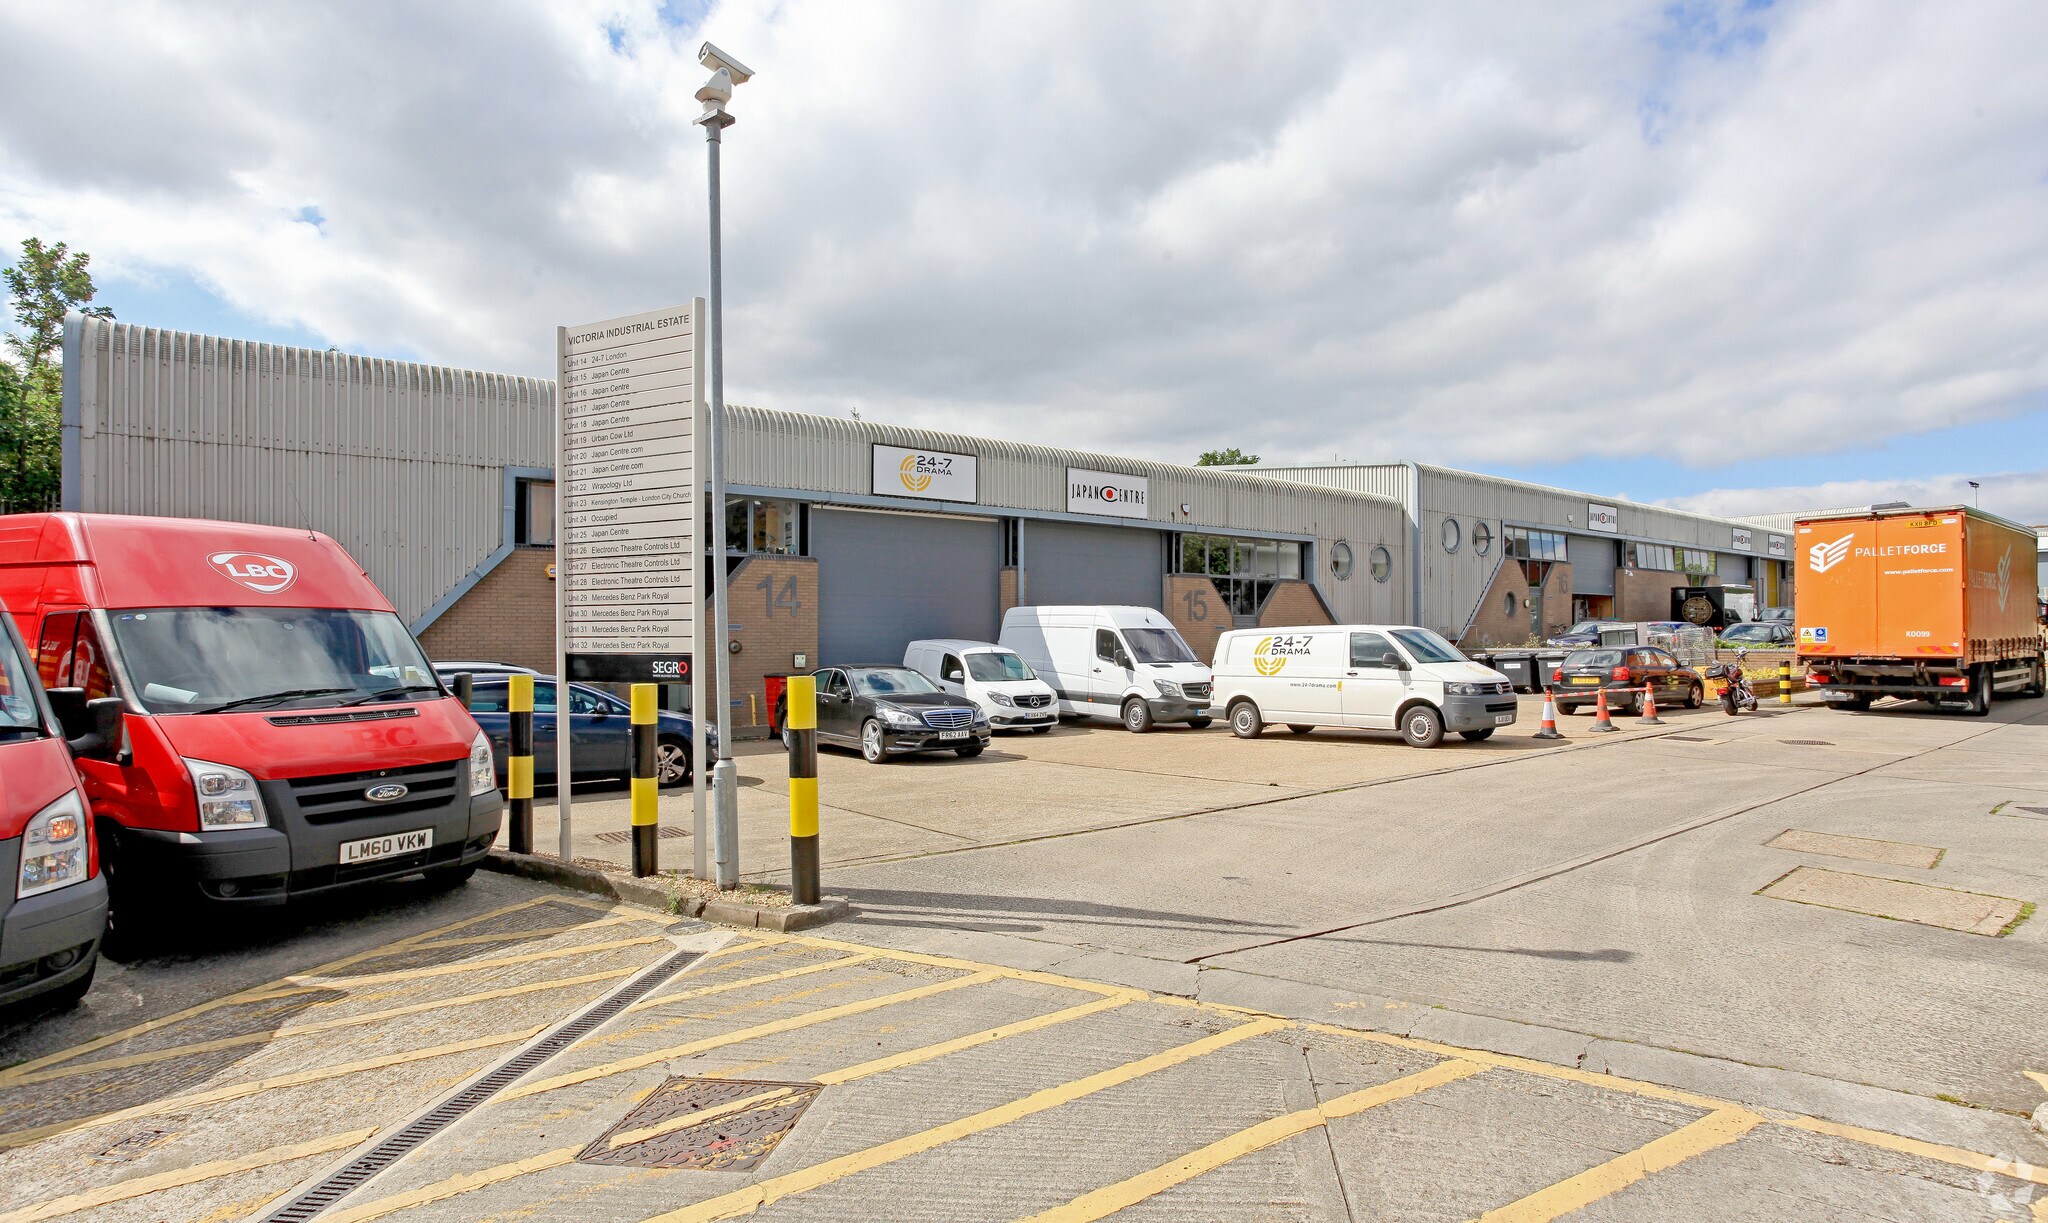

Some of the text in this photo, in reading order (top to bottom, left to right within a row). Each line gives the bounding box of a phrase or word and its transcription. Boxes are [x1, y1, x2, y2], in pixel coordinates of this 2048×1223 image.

[568, 314, 690, 345] VICTORIA INDUSTRIAL ESTATE
[567, 358, 579, 368] Unit
[592, 355, 604, 363] 24-7
[606, 351, 627, 361] London
[567, 368, 630, 383] Unit 15 Japan Centre
[567, 390, 579, 399] Unit
[591, 387, 609, 396] Japan
[610, 383, 630, 393] Centre
[567, 405, 579, 415] Unit
[591, 403, 609, 412] Japan
[610, 399, 630, 408] Centre
[567, 415, 630, 430] Unit 18 Japan Centre
[567, 437, 579, 446] Unit
[591, 434, 609, 443] Urban
[610, 432, 622, 440] Cow
[624, 430, 633, 438] Ltd
[567, 452, 579, 461] Unit
[580, 452, 587, 460] 20
[591, 450, 609, 459] Japan
[916, 455, 953, 469] 24-7
[567, 468, 579, 477] Unit
[591, 466, 609, 475] Japan
[916, 466, 953, 476] DRAMA
[567, 483, 579, 493] Unit
[592, 481, 622, 490] Wrapology
[623, 479, 632, 487] Ltd
[1071, 483, 1099, 500] JAPAN
[567, 499, 579, 508] Unit
[580, 499, 587, 507] 23
[591, 498, 618, 507] Kensington
[620, 496, 637, 504] Temple
[642, 494, 661, 502] London
[673, 491, 691, 499] Church
[567, 513, 618, 523] Unit 24 Occupied
[567, 530, 579, 539] Unit
[591, 529, 609, 538] Japan
[610, 528, 629, 536] Centre
[567, 546, 579, 554] Unit
[591, 546, 619, 554] Electronic
[621, 544, 642, 552] Theatre
[644, 542, 669, 551] Controls
[1855, 543, 1946, 557] PALLETFORCE
[567, 558, 680, 570] Unit 27 Electronic Theatre Controls Ltd
[225, 563, 288, 579] LBC
[1883, 567, 1954, 575] www.palletforce.com
[568, 574, 680, 587] Unit 28 Electronic Theatre Controls Ltd
[568, 593, 579, 601] Unit
[591, 593, 619, 601] Mercedes
[637, 592, 650, 600] Park
[652, 592, 669, 600] Royal
[756, 575, 800, 617] 14
[1182, 589, 1208, 622] 15
[568, 609, 579, 617] Unit
[591, 609, 619, 617] Mercedes
[652, 608, 669, 617] Royal
[568, 625, 579, 633] Unit
[591, 625, 619, 633] Mercedes
[652, 624, 669, 633] Royal
[568, 641, 579, 649] Unit
[580, 641, 587, 649] 32
[591, 641, 619, 649] Mercedes
[621, 641, 635, 649] Benz
[652, 641, 669, 650] Royal
[1272, 635, 1313, 648] 24-7
[1271, 648, 1311, 656] DRAMA
[652, 661, 688, 674] SEGRO
[377, 787, 401, 798] Ford
[348, 832, 427, 860] LM60 VKW
